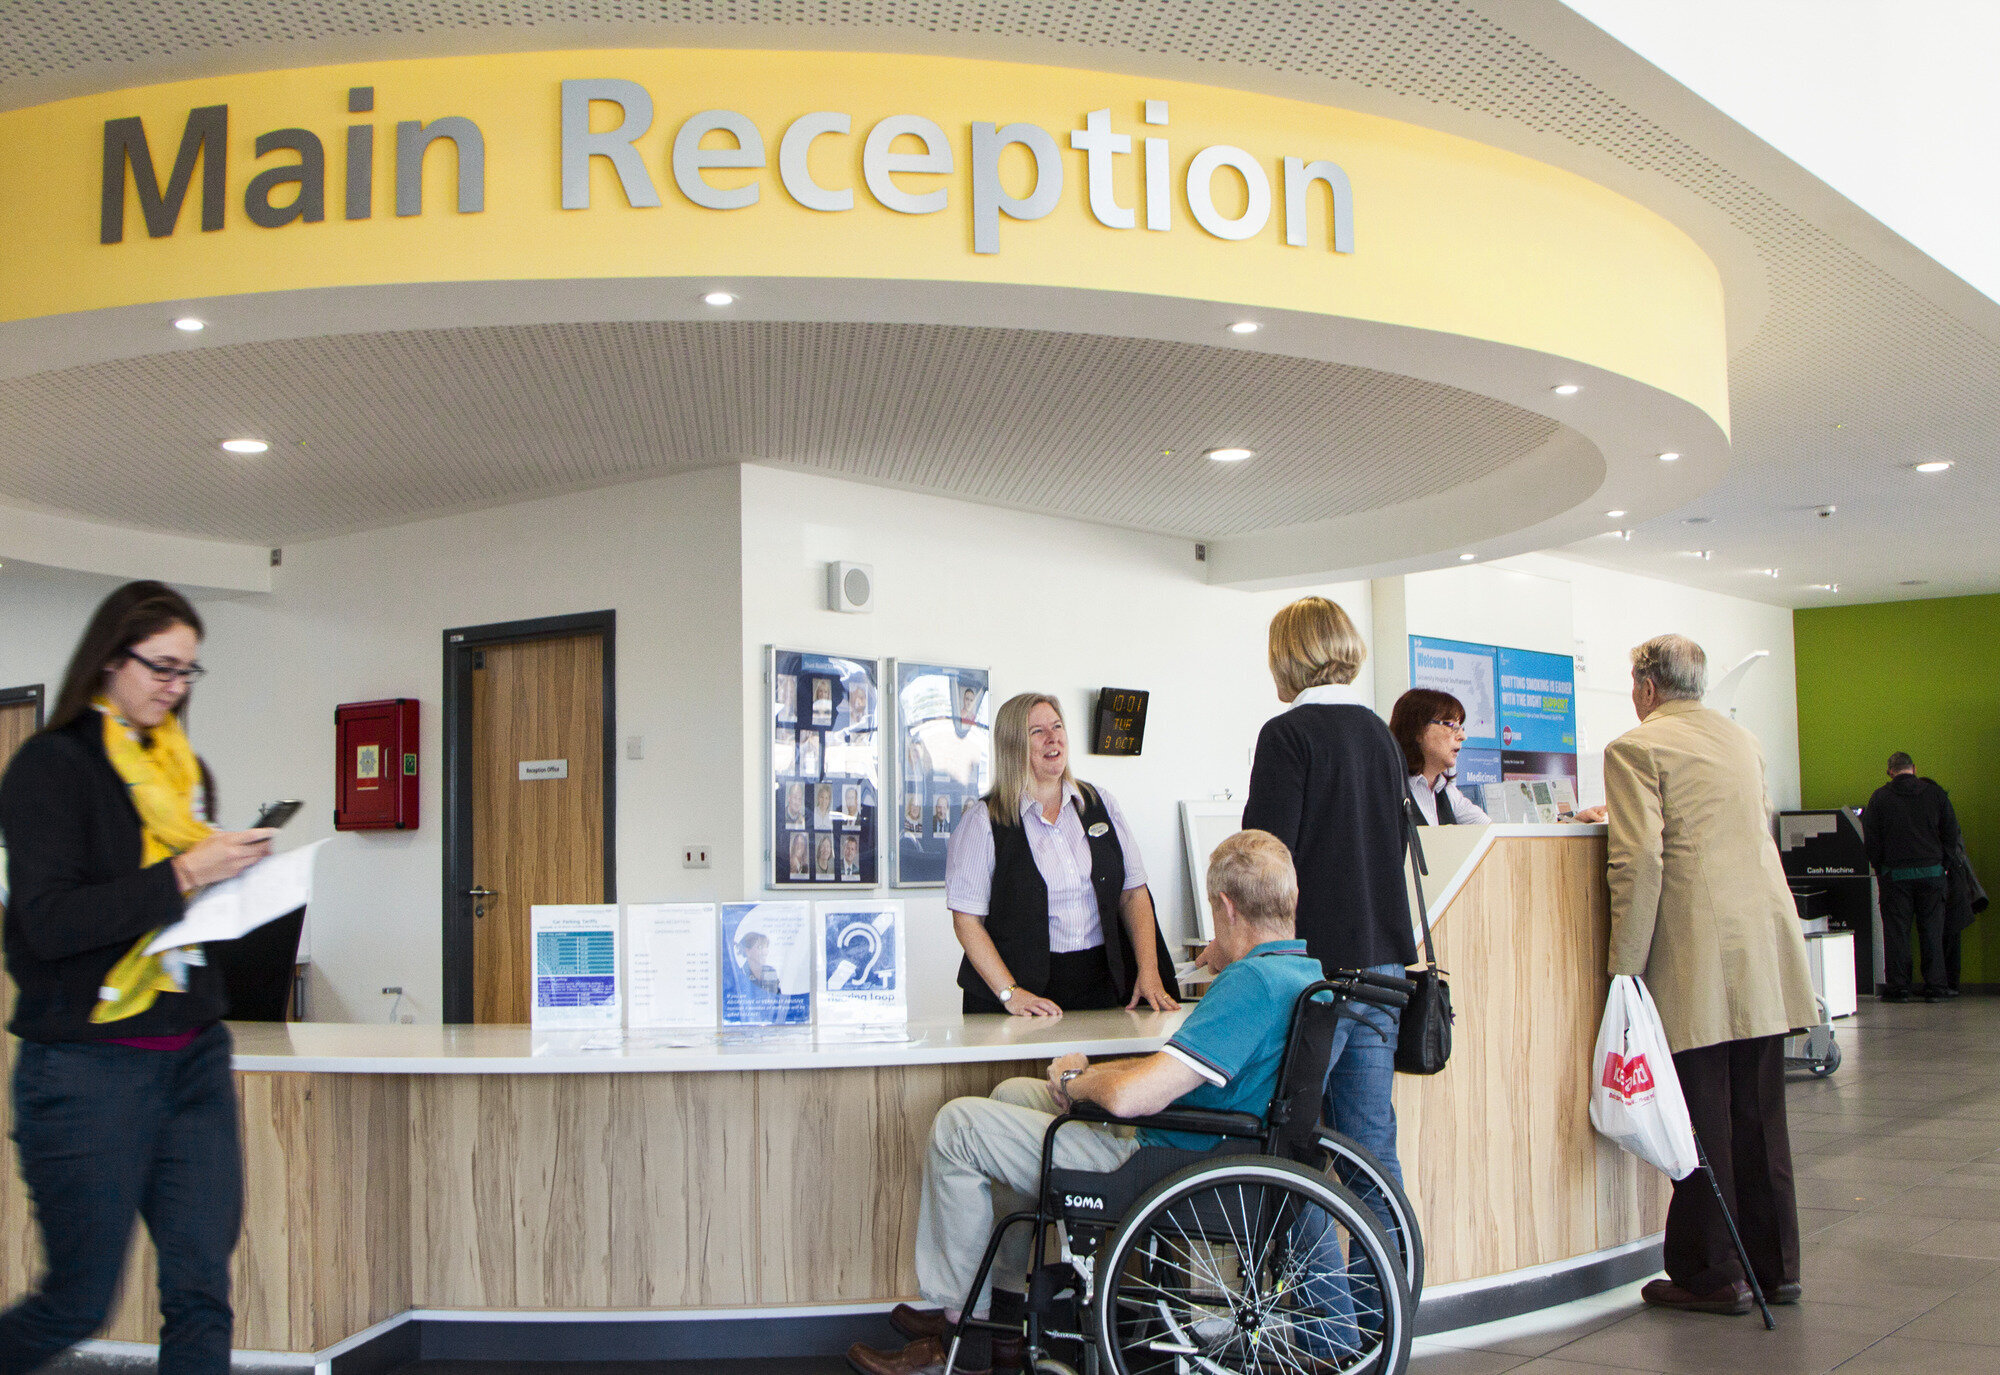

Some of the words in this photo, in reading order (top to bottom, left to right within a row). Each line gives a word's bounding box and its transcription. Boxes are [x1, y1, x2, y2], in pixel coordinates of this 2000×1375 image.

[99, 86, 485, 245] Main
[562, 78, 1355, 254] Reception
[1417, 652, 1447, 669] Welcome
[1448, 656, 1454, 670] to
[1501, 675, 1526, 689] QUITTING
[1526, 678, 1549, 692] SMOKING
[1550, 680, 1555, 693] IS
[1555, 681, 1572, 695] EASIER
[1501, 692, 1516, 705] WITH
[1516, 693, 1526, 706] THE
[1527, 695, 1542, 708] RIGHT
[1542, 697, 1569, 711] SUPPORT
[1115, 718, 1133, 730] TUE
[1105, 735, 1112, 749] 9
[1115, 736, 1135, 749] OCT
[1466, 772, 1498, 783] Medicines
[870, 993, 895, 1002] Loop
[1064, 1194, 1104, 1210] SOMA
